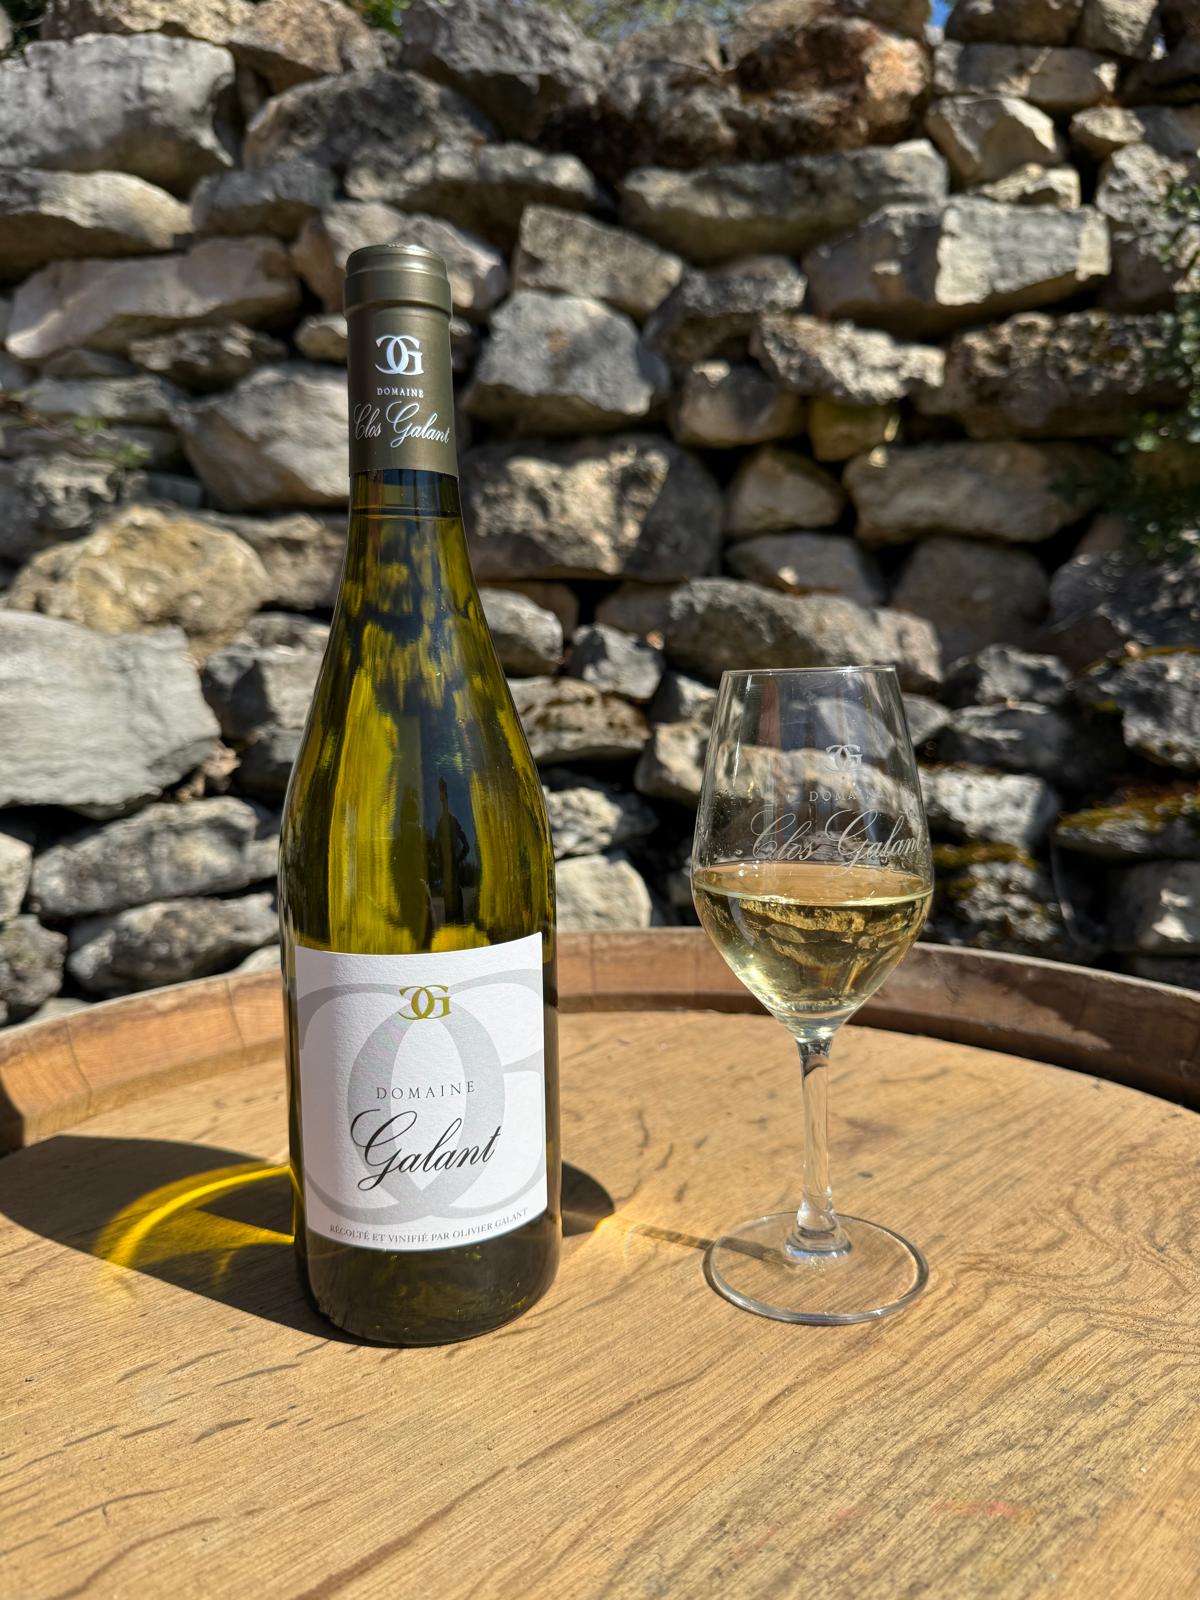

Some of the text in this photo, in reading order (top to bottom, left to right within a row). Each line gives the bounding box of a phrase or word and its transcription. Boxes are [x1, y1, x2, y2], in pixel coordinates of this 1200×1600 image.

[377, 387, 424, 398] DOMAINE
[353, 401, 450, 448] Clos Galant
[750, 809, 813, 861] Clos
[376, 1080, 475, 1100] DOMAINE
[350, 1108, 502, 1191] Galant
[329, 1207, 529, 1243] RÉCOLTÉ ET VINIFIÉ PAR OLIVIER GALANT
